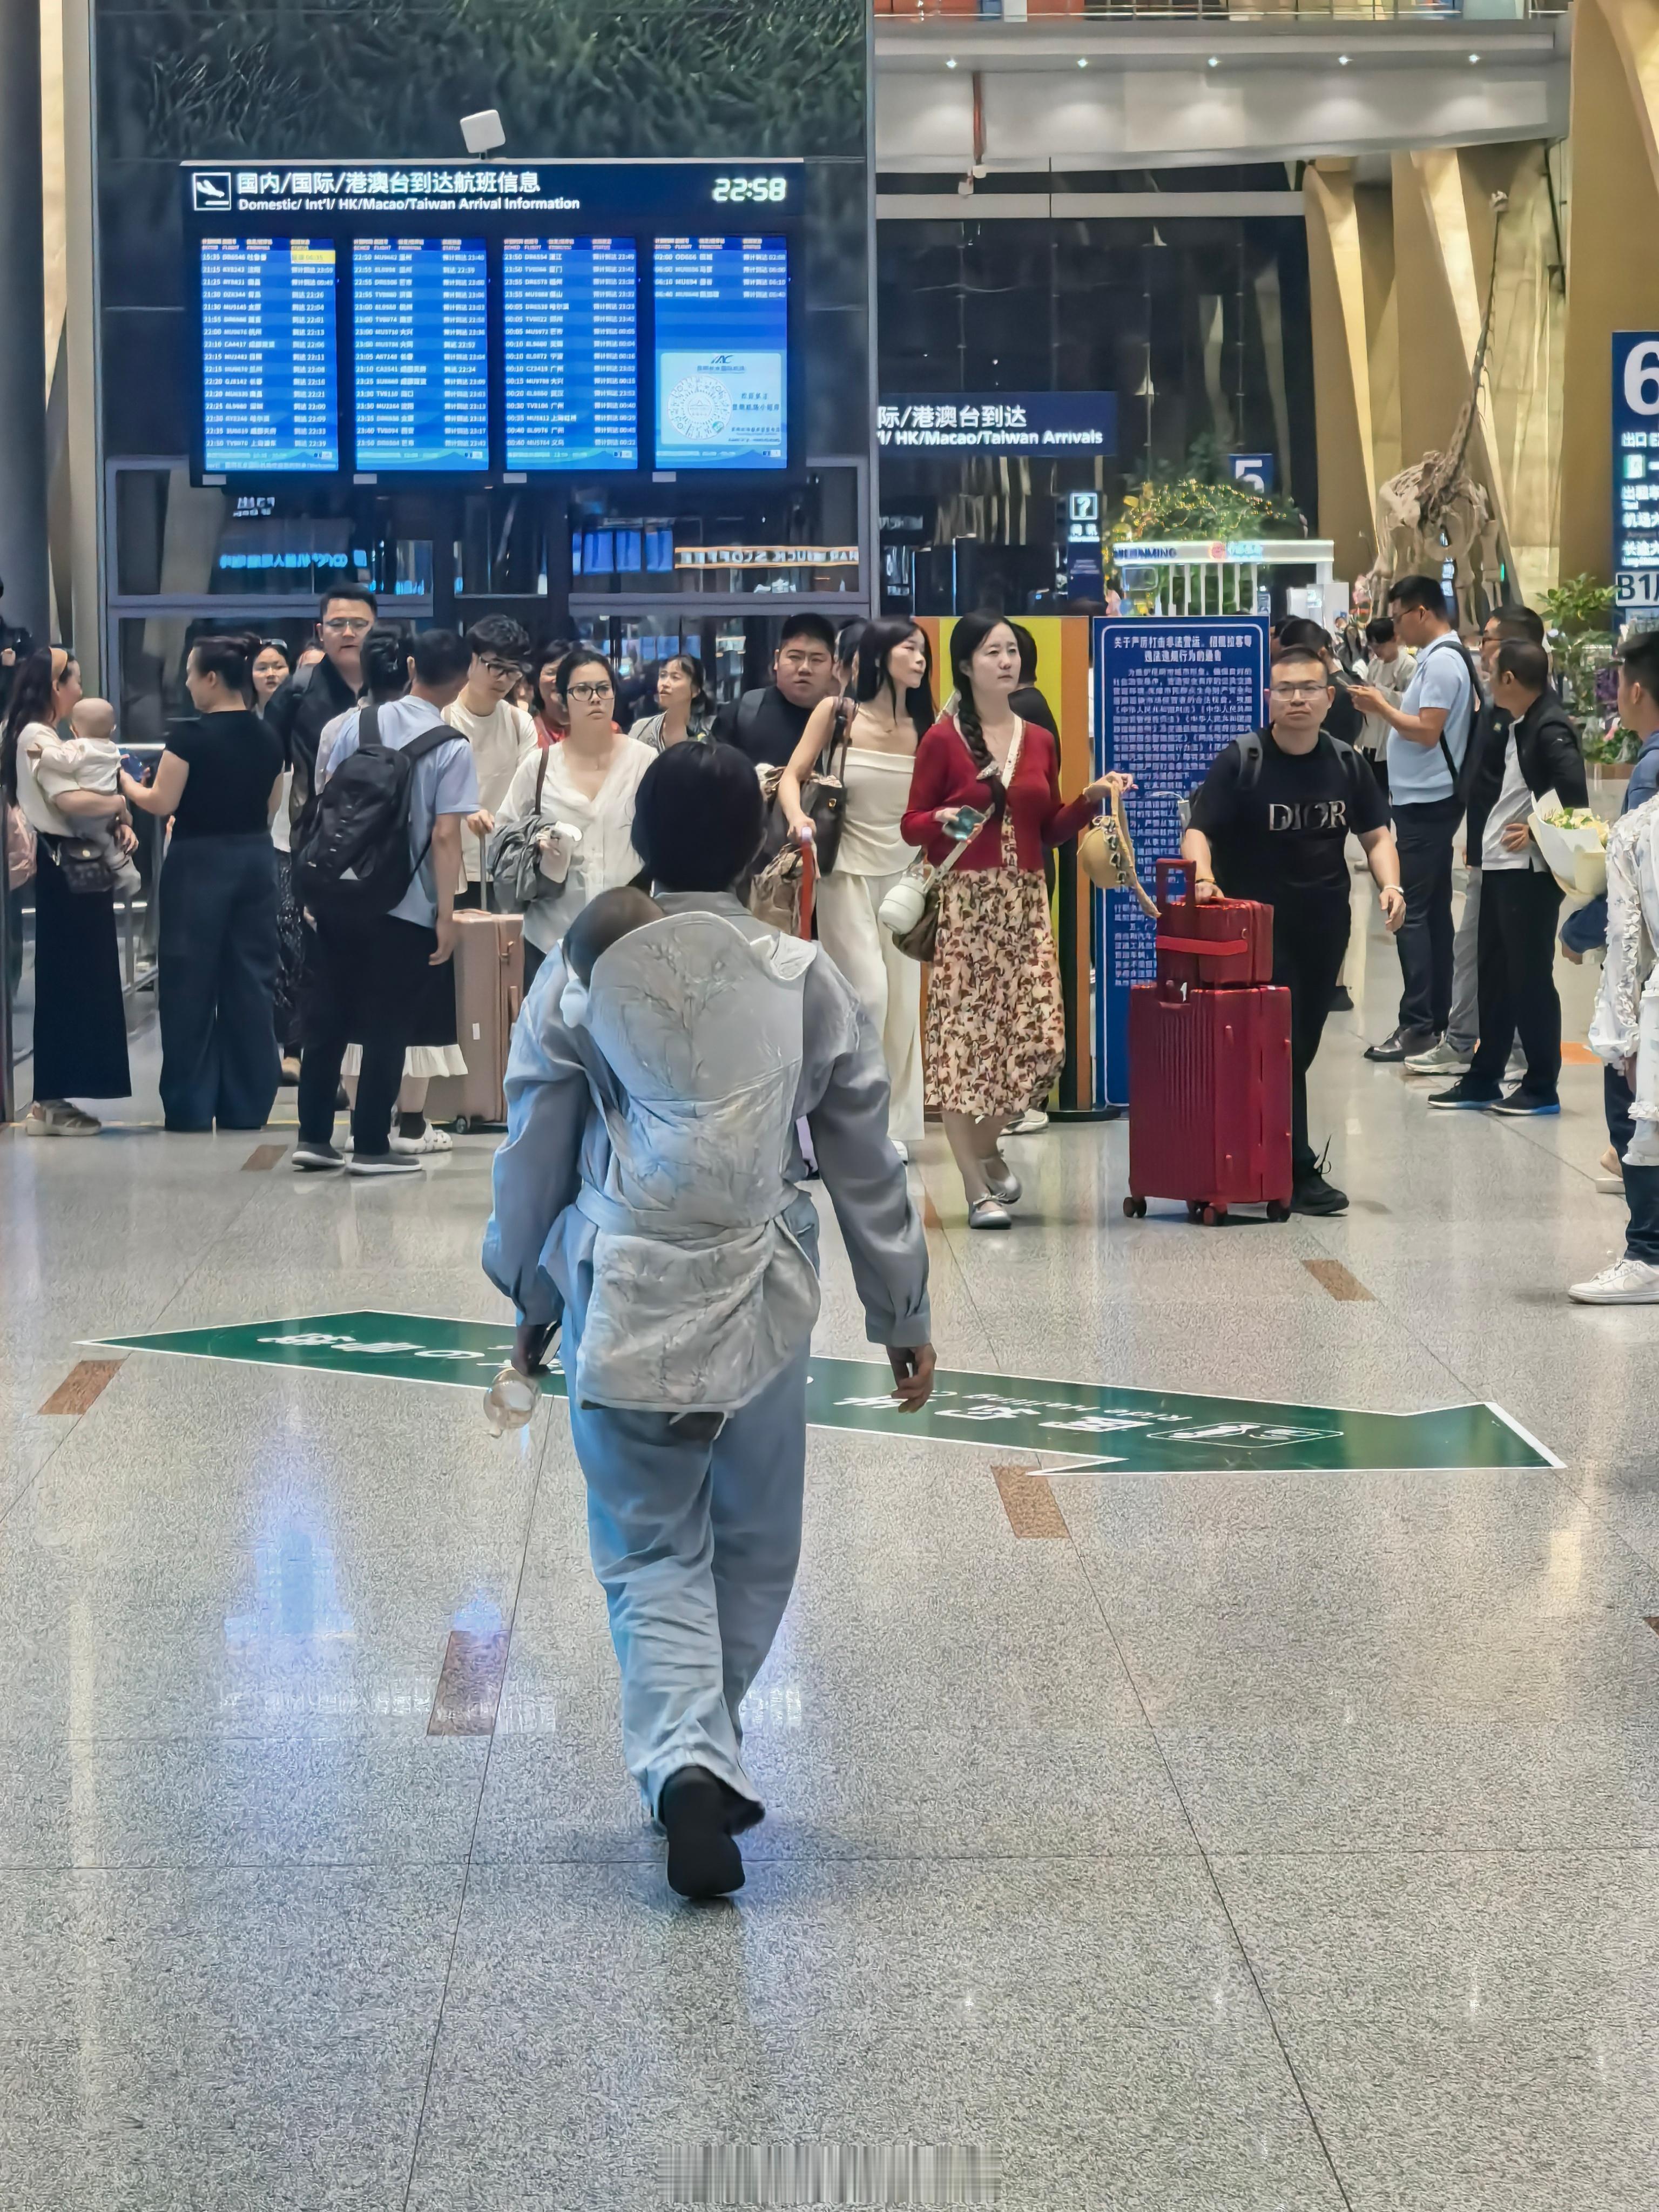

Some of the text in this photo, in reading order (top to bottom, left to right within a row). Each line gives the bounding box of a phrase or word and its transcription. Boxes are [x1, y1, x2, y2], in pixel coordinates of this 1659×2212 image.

[238, 172, 541, 194] 国内/国际/港澳台到达航班信息
[712, 177, 786, 201] 22:58
[239, 198, 302, 211] Domestic/
[339, 198, 455, 211] HK/Macao/Taiwan
[460, 198, 502, 211] Arrival
[505, 198, 580, 210] Information
[1624, 341, 1659, 415] 6
[878, 405, 1027, 429] 际/港澳台到达
[896, 430, 1038, 445] HK/Macao/Taiwan
[1042, 429, 1103, 444] Arrivals
[1622, 432, 1647, 447] 出口
[1236, 460, 1264, 493] 5
[1269, 800, 1346, 831] DIOR
[961, 1393, 1101, 1411] Hailing
[1103, 1408, 1192, 1421] Ride
